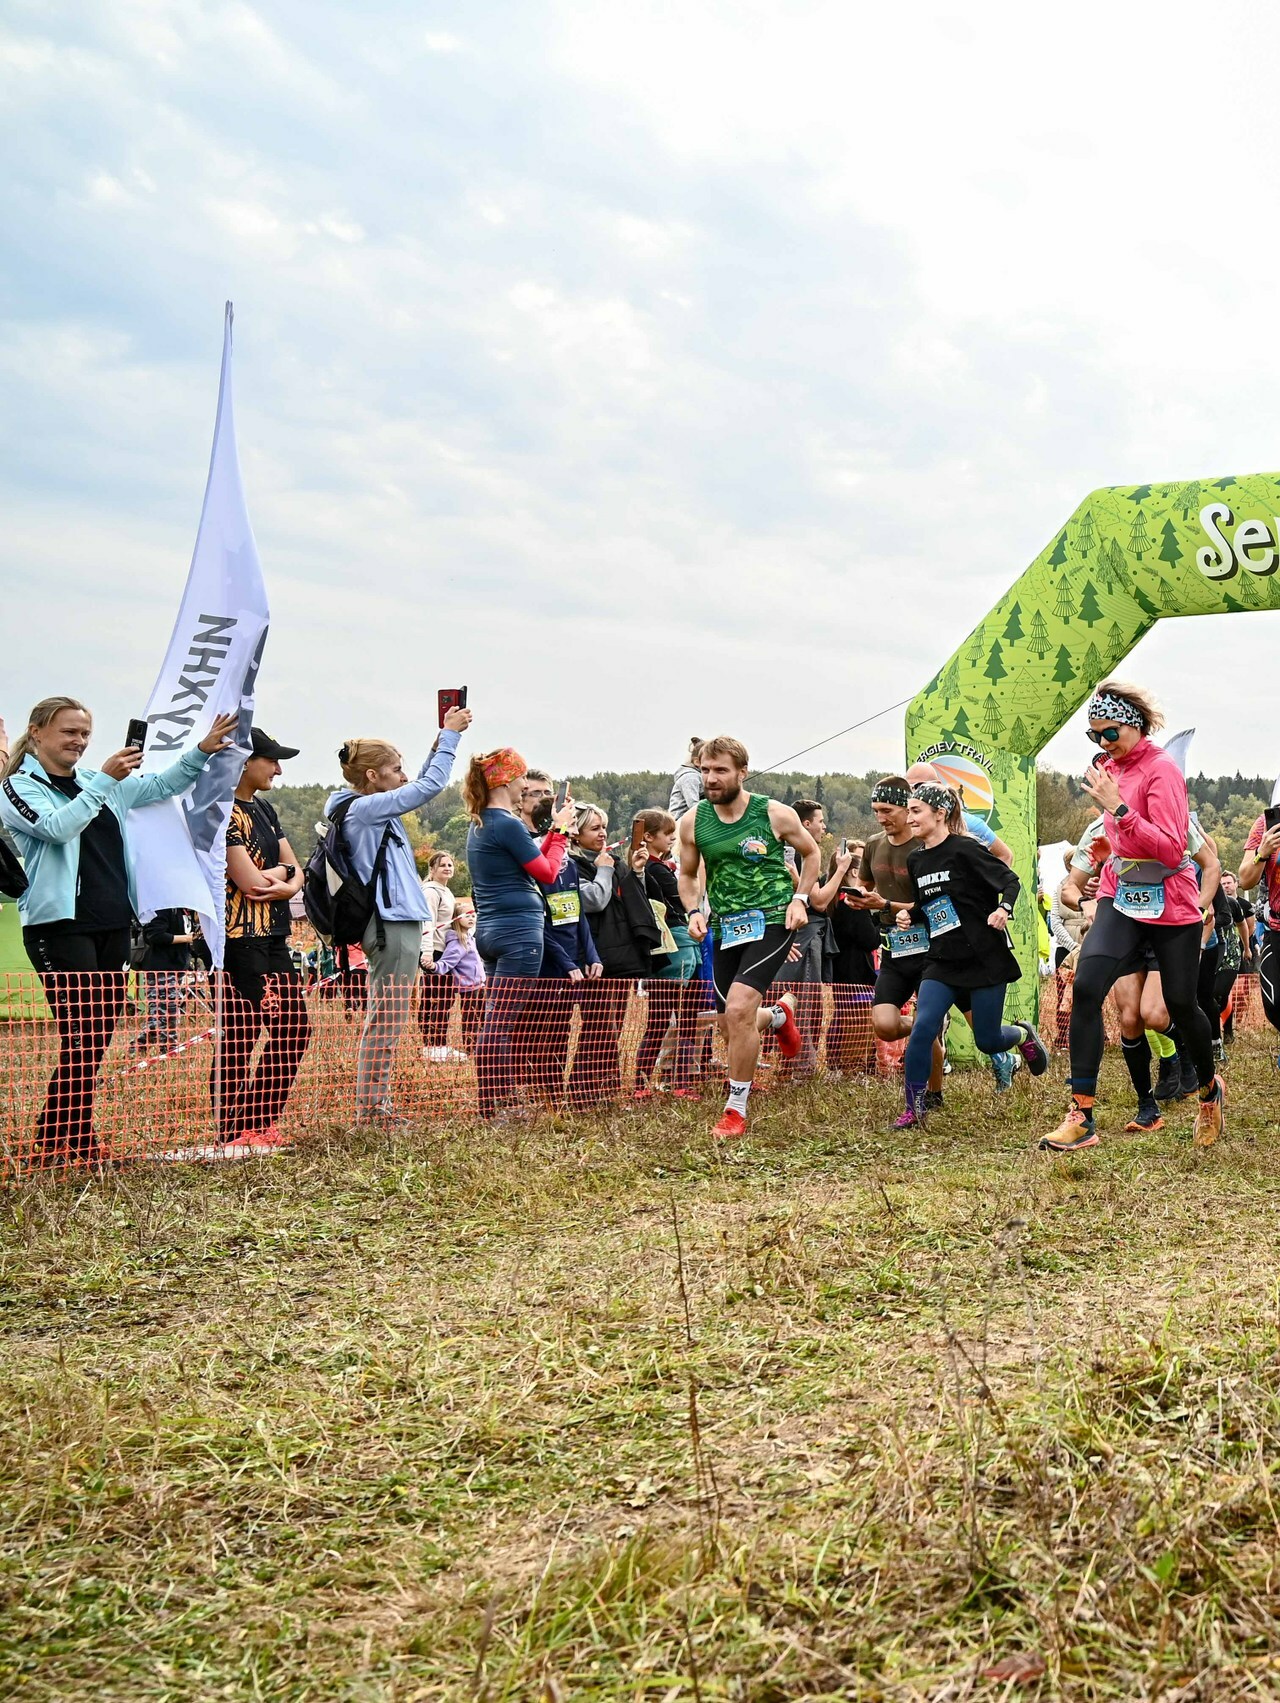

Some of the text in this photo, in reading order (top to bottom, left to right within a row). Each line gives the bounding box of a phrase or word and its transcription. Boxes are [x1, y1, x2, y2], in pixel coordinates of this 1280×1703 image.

[957, 743, 995, 775] TRAIL
[917, 870, 951, 888] MIXX
[1125, 891, 1151, 904] 645
[733, 922, 753, 936] 551
[898, 933, 919, 946] 548
